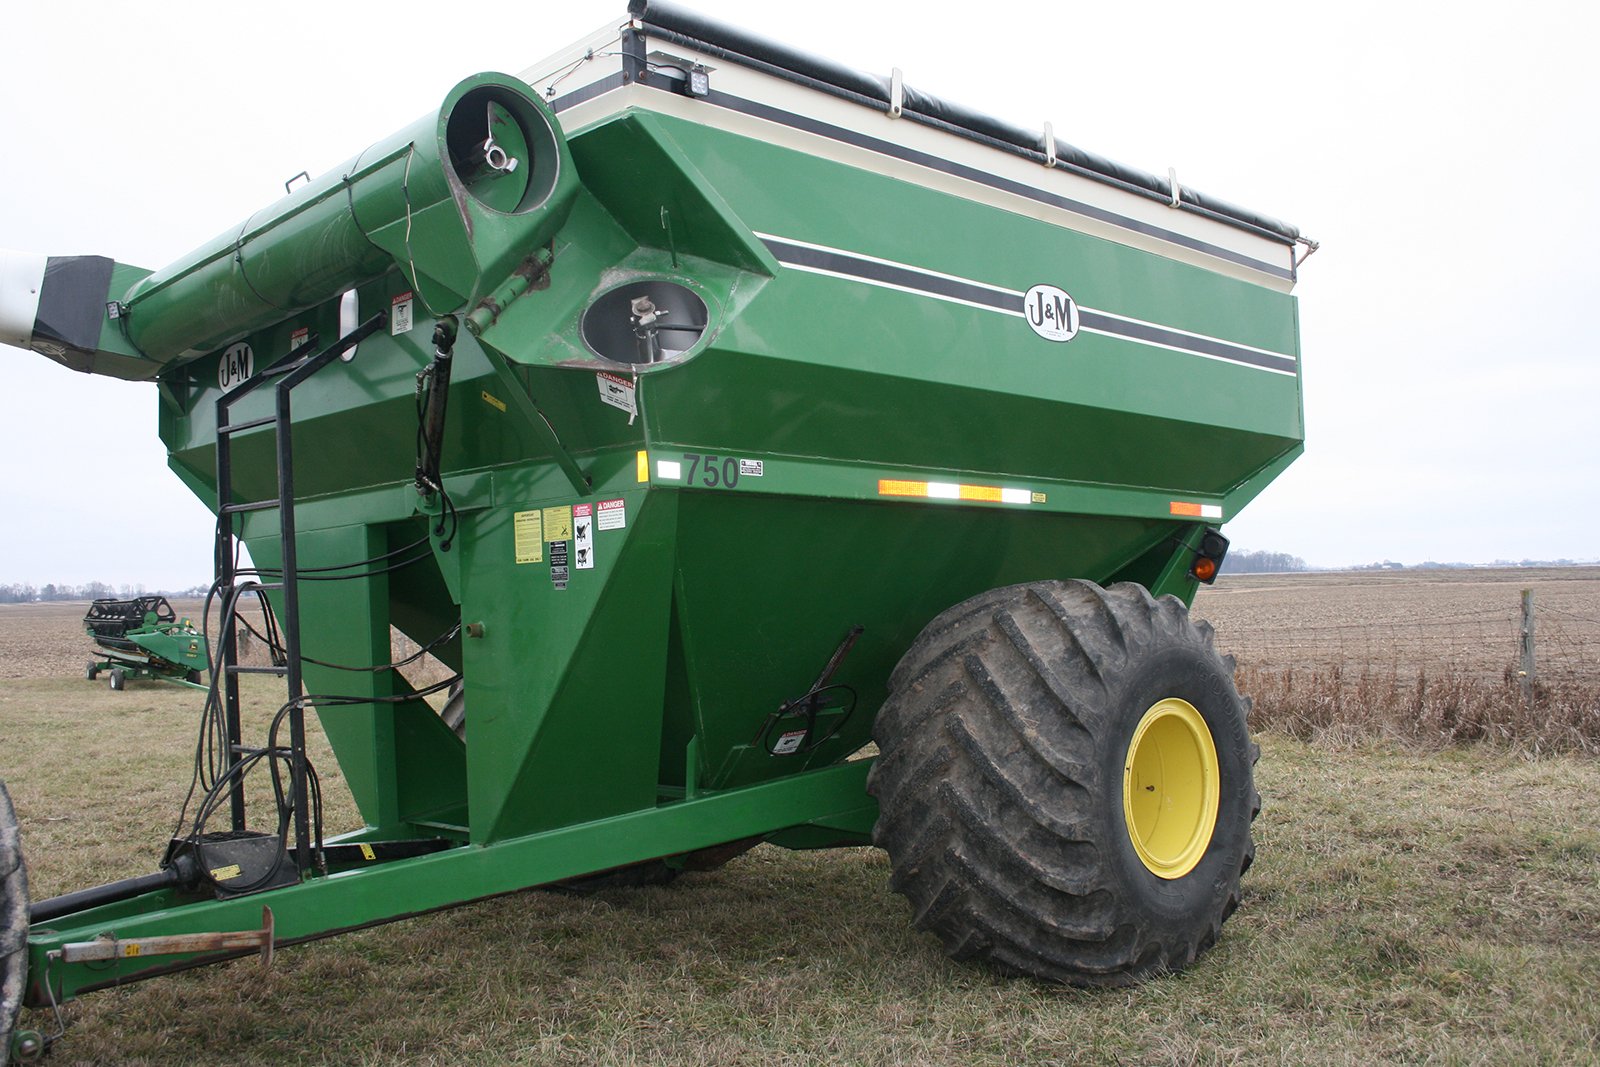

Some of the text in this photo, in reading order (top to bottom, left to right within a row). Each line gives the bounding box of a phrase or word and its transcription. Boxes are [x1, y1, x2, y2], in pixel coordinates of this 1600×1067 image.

[1029, 291, 1073, 333] J&M
[221, 346, 249, 387] J&M
[602, 372, 633, 389] DANGER
[683, 453, 738, 488] 750
[603, 500, 624, 510] DANGER
